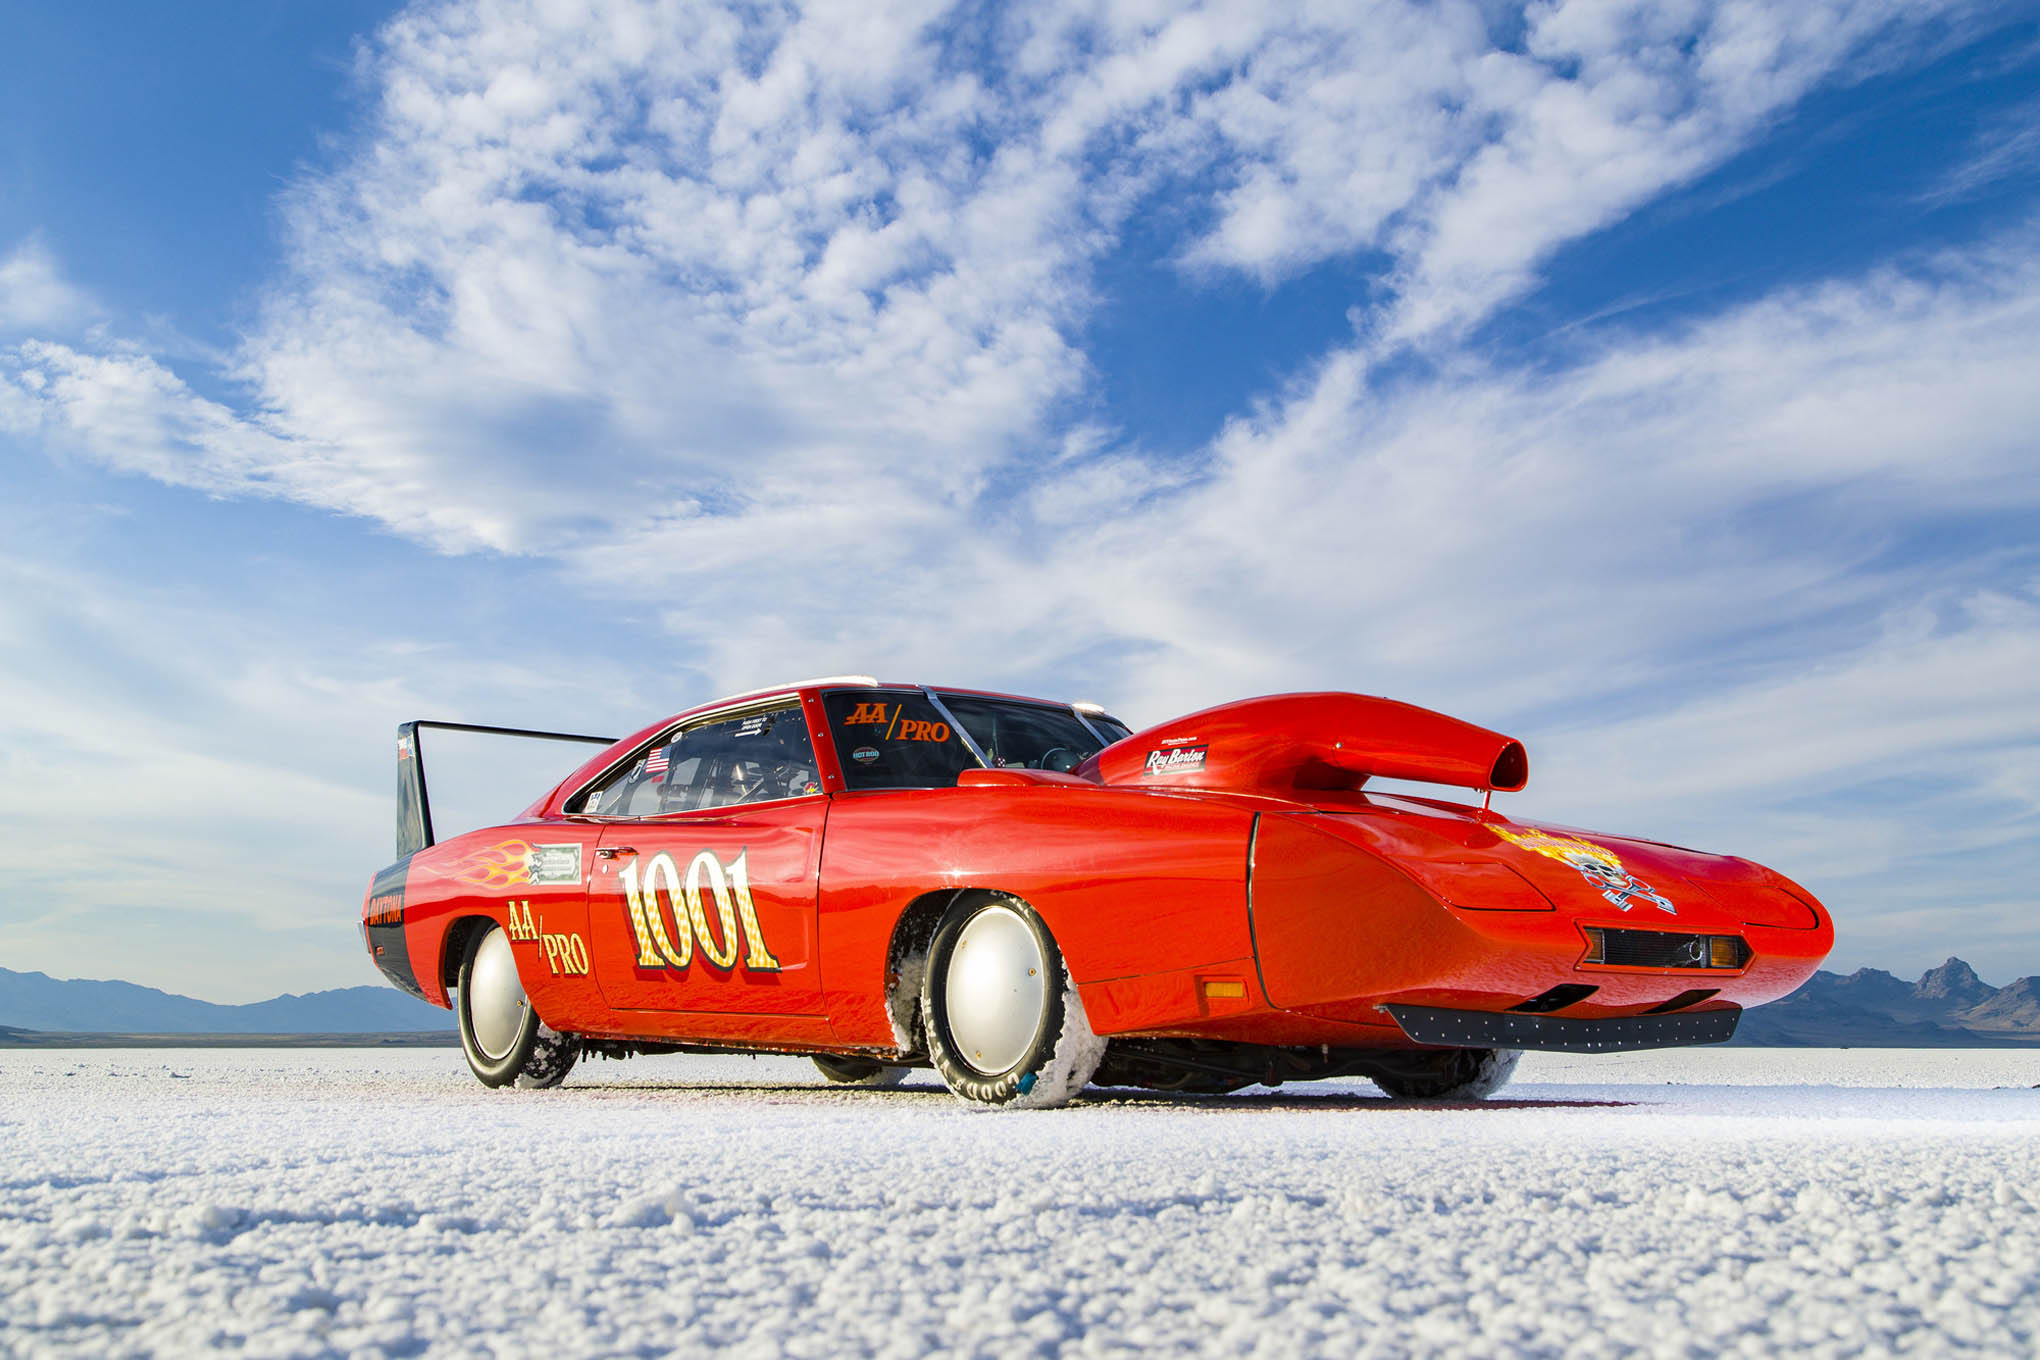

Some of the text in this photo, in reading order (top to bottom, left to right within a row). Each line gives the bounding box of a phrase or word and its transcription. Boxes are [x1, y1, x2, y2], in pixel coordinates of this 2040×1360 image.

[853, 751, 866, 759] HOT
[1146, 748, 1205, 775] Ray Barton
[618, 846, 781, 972] 1001
